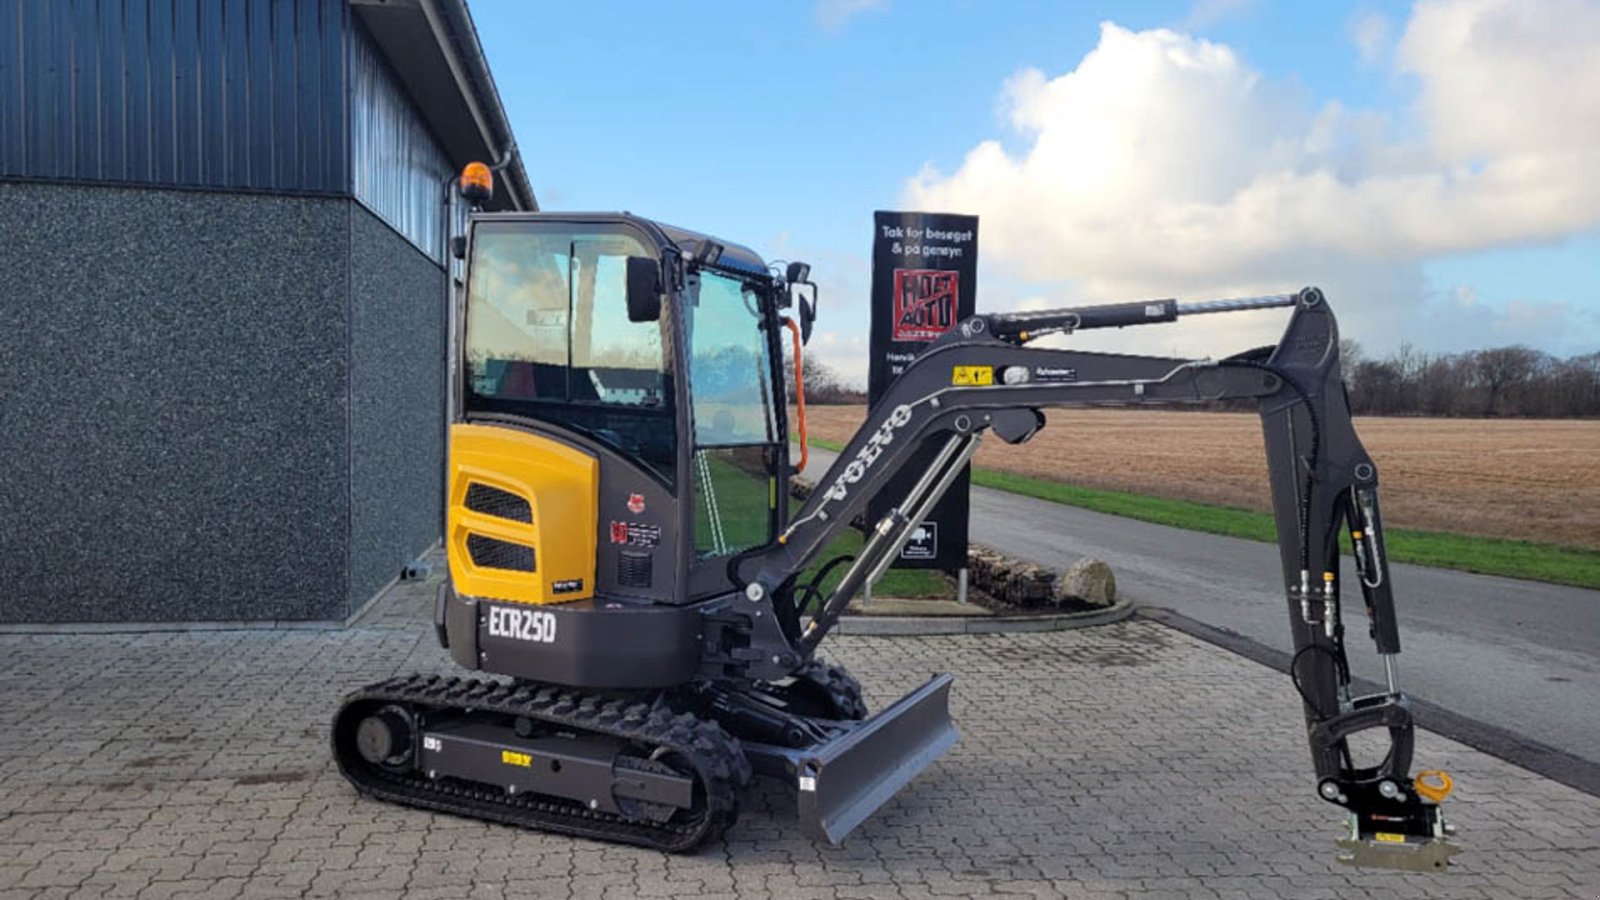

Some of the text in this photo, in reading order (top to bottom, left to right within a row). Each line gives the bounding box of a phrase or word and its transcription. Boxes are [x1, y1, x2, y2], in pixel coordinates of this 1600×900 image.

[882, 225, 904, 238] Tak
[906, 226, 923, 238] for
[891, 241, 902, 254] &
[822, 404, 912, 501] VOLVO
[489, 605, 556, 643] ECR25D
